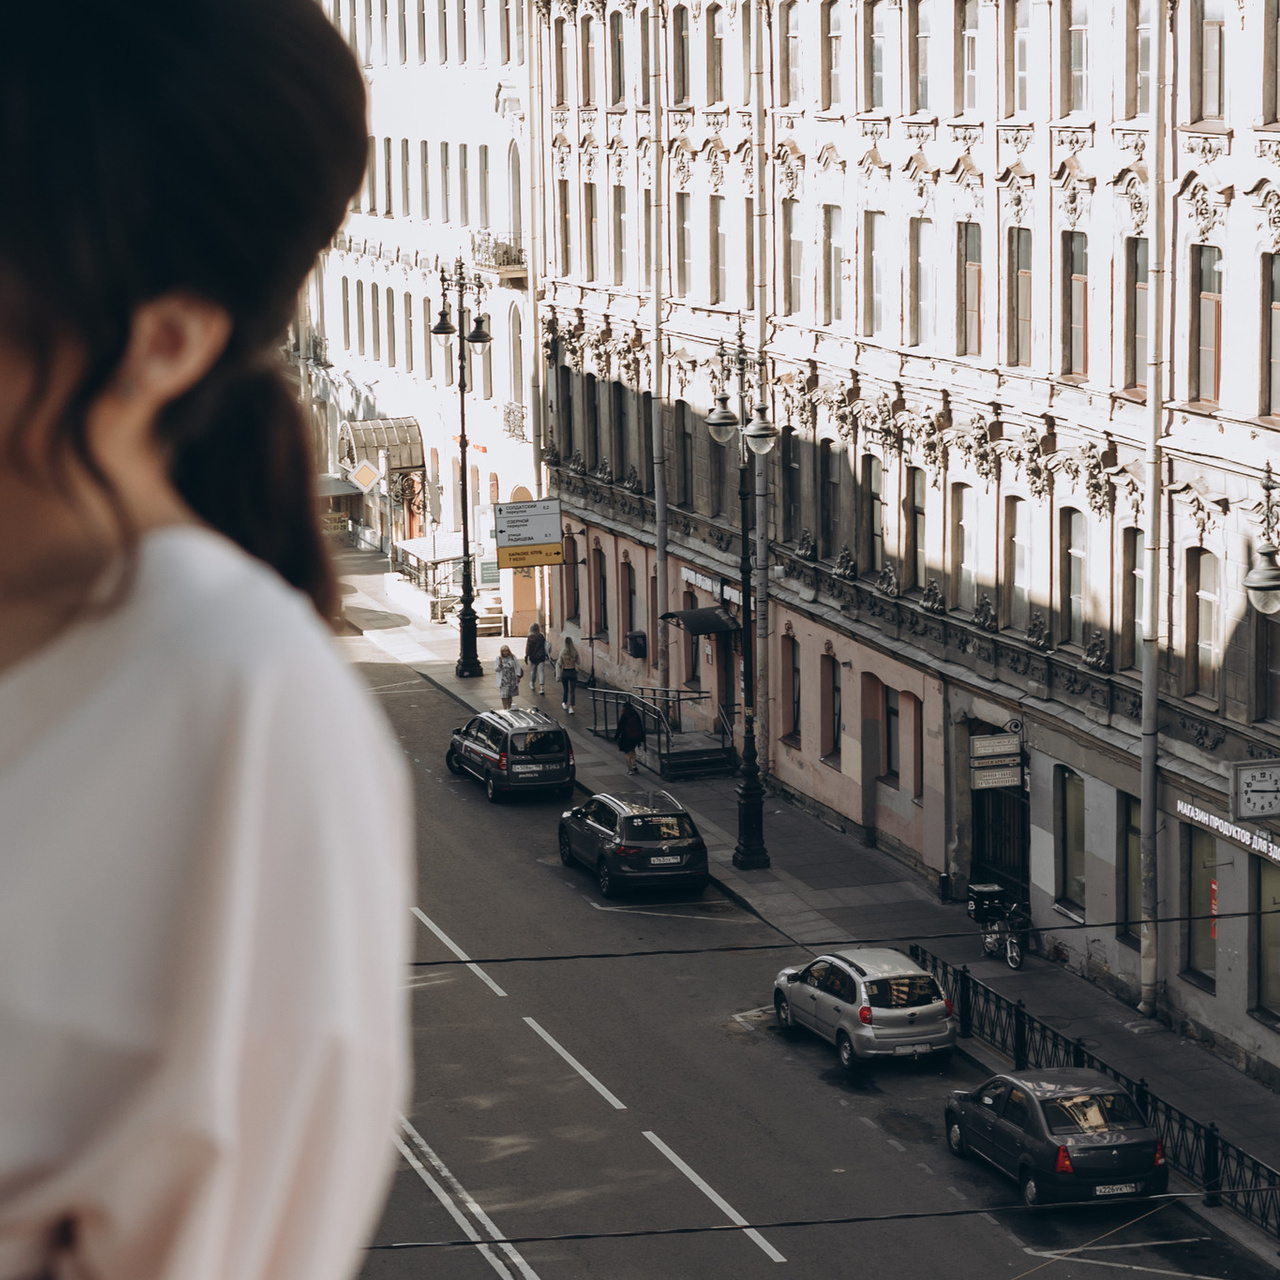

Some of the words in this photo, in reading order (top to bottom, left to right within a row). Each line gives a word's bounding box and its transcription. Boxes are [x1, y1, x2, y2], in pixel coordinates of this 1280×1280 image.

[1177, 799, 1209, 826] МАГАЗИН
[1209, 814, 1251, 845] ПРОДУКТОВ
[1251, 835, 1268, 854] ДЛЯ
